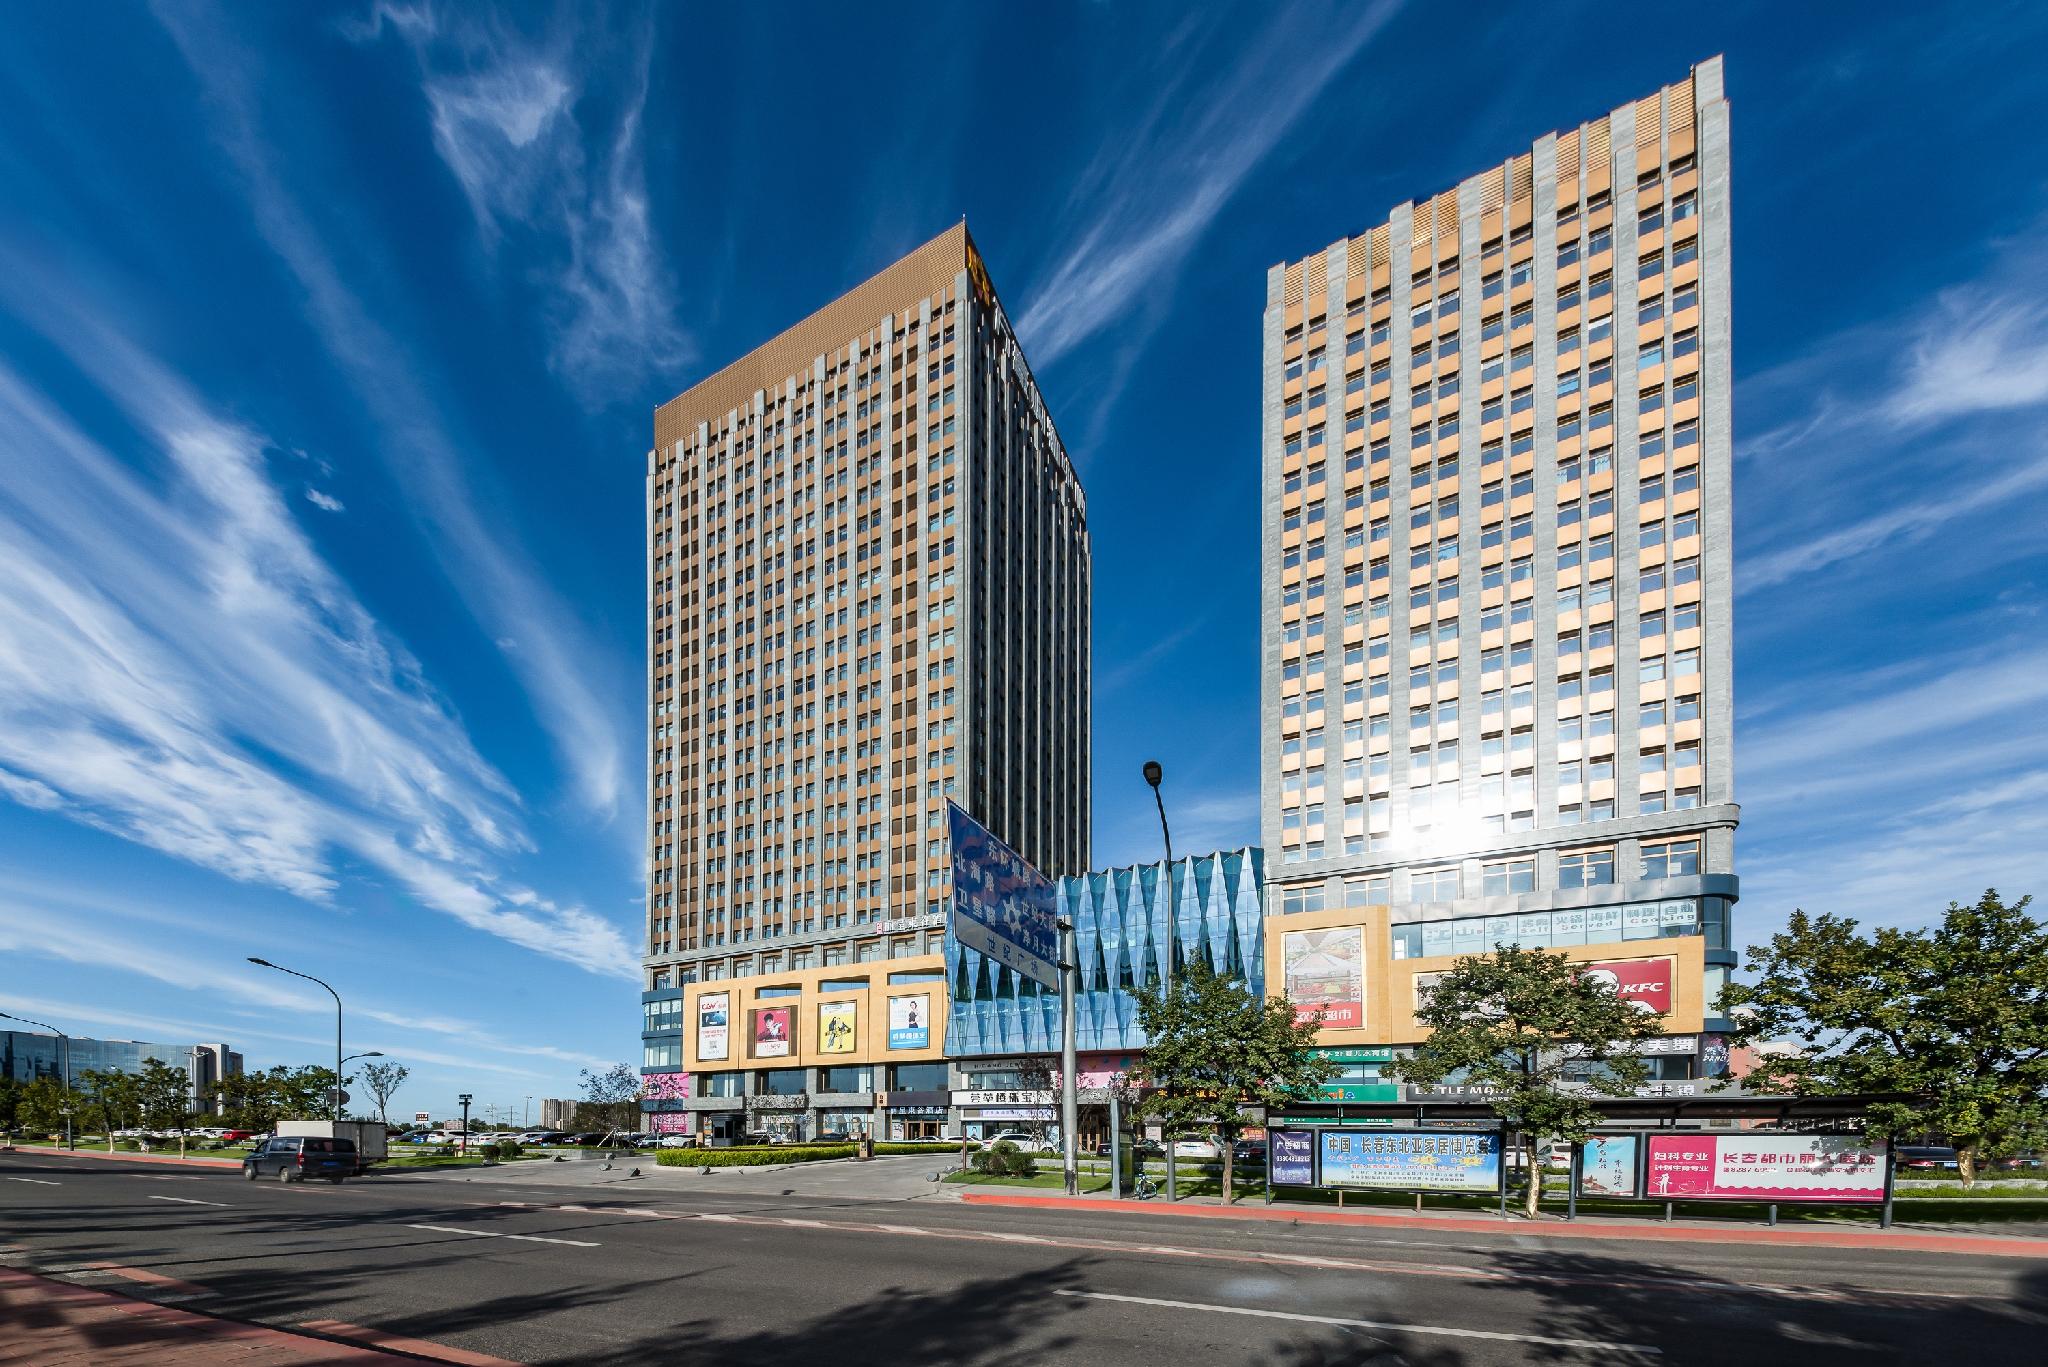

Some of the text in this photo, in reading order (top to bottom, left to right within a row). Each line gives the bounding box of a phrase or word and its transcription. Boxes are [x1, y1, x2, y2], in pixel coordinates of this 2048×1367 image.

[957, 887, 996, 927] 卫星路
[986, 935, 1039, 976] 世纪广场
[1620, 982, 1665, 993] KFC
[1276, 1139, 1309, 1149] 广告招商
[1654, 1152, 1708, 1160] 妇科专业
